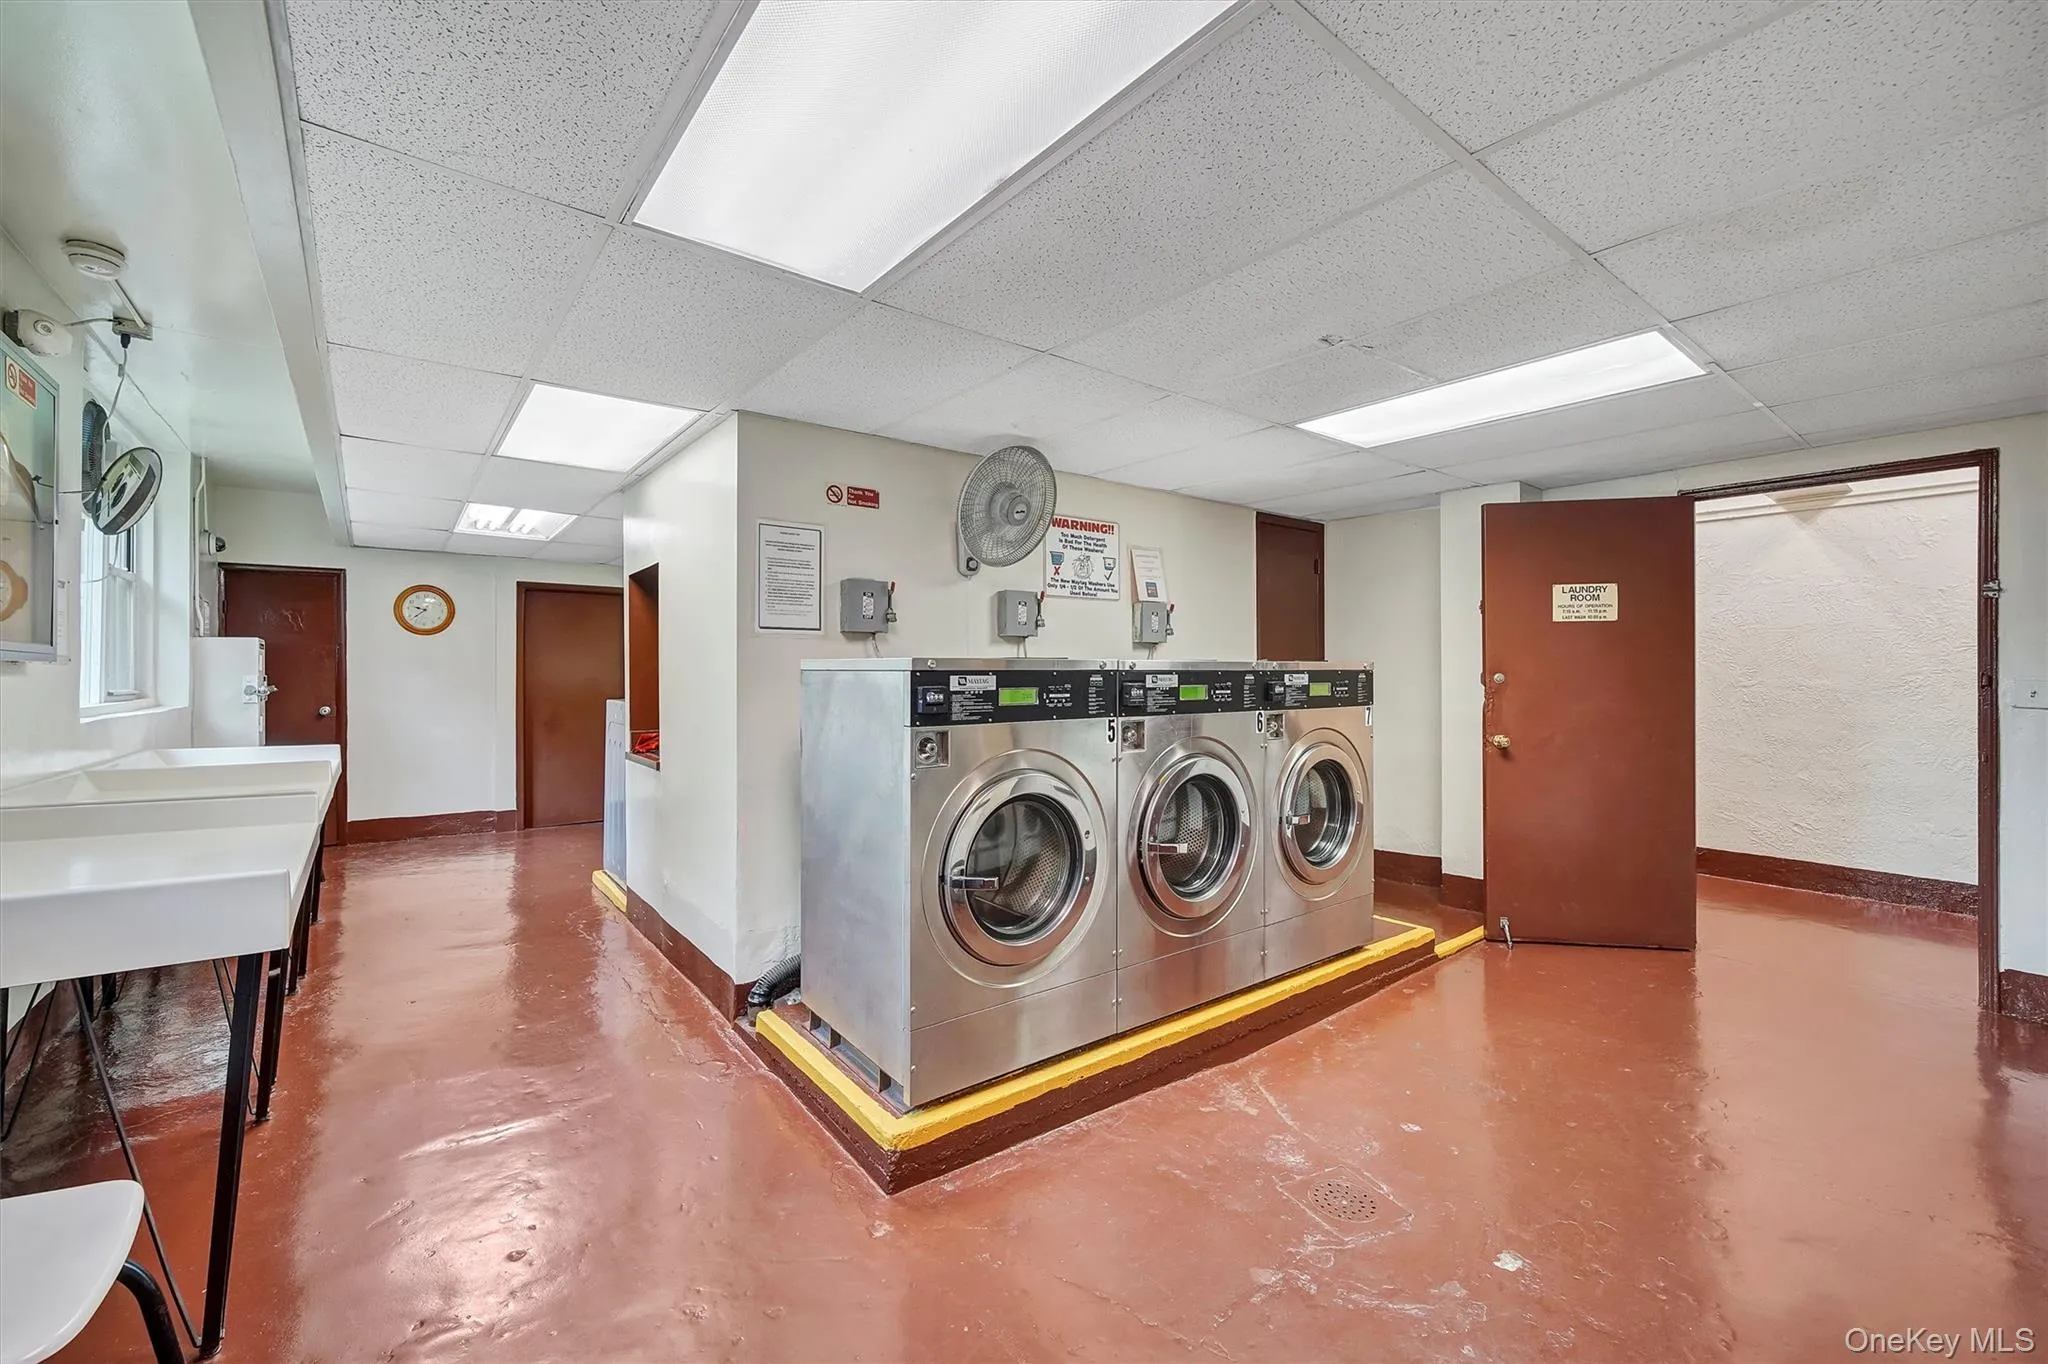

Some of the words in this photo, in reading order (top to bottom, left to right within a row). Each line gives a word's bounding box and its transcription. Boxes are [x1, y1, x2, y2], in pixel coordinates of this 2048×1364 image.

[1051, 517, 1115, 535] WARNING!!
[1083, 534, 1106, 543] Detergent
[1092, 541, 1108, 549] Health
[1561, 585, 1608, 594] LAUNDRY
[1570, 593, 1601, 602] ROOM
[1256, 711, 1263, 732] 6
[1366, 706, 1371, 725] 7
[1107, 719, 1116, 743] 5
